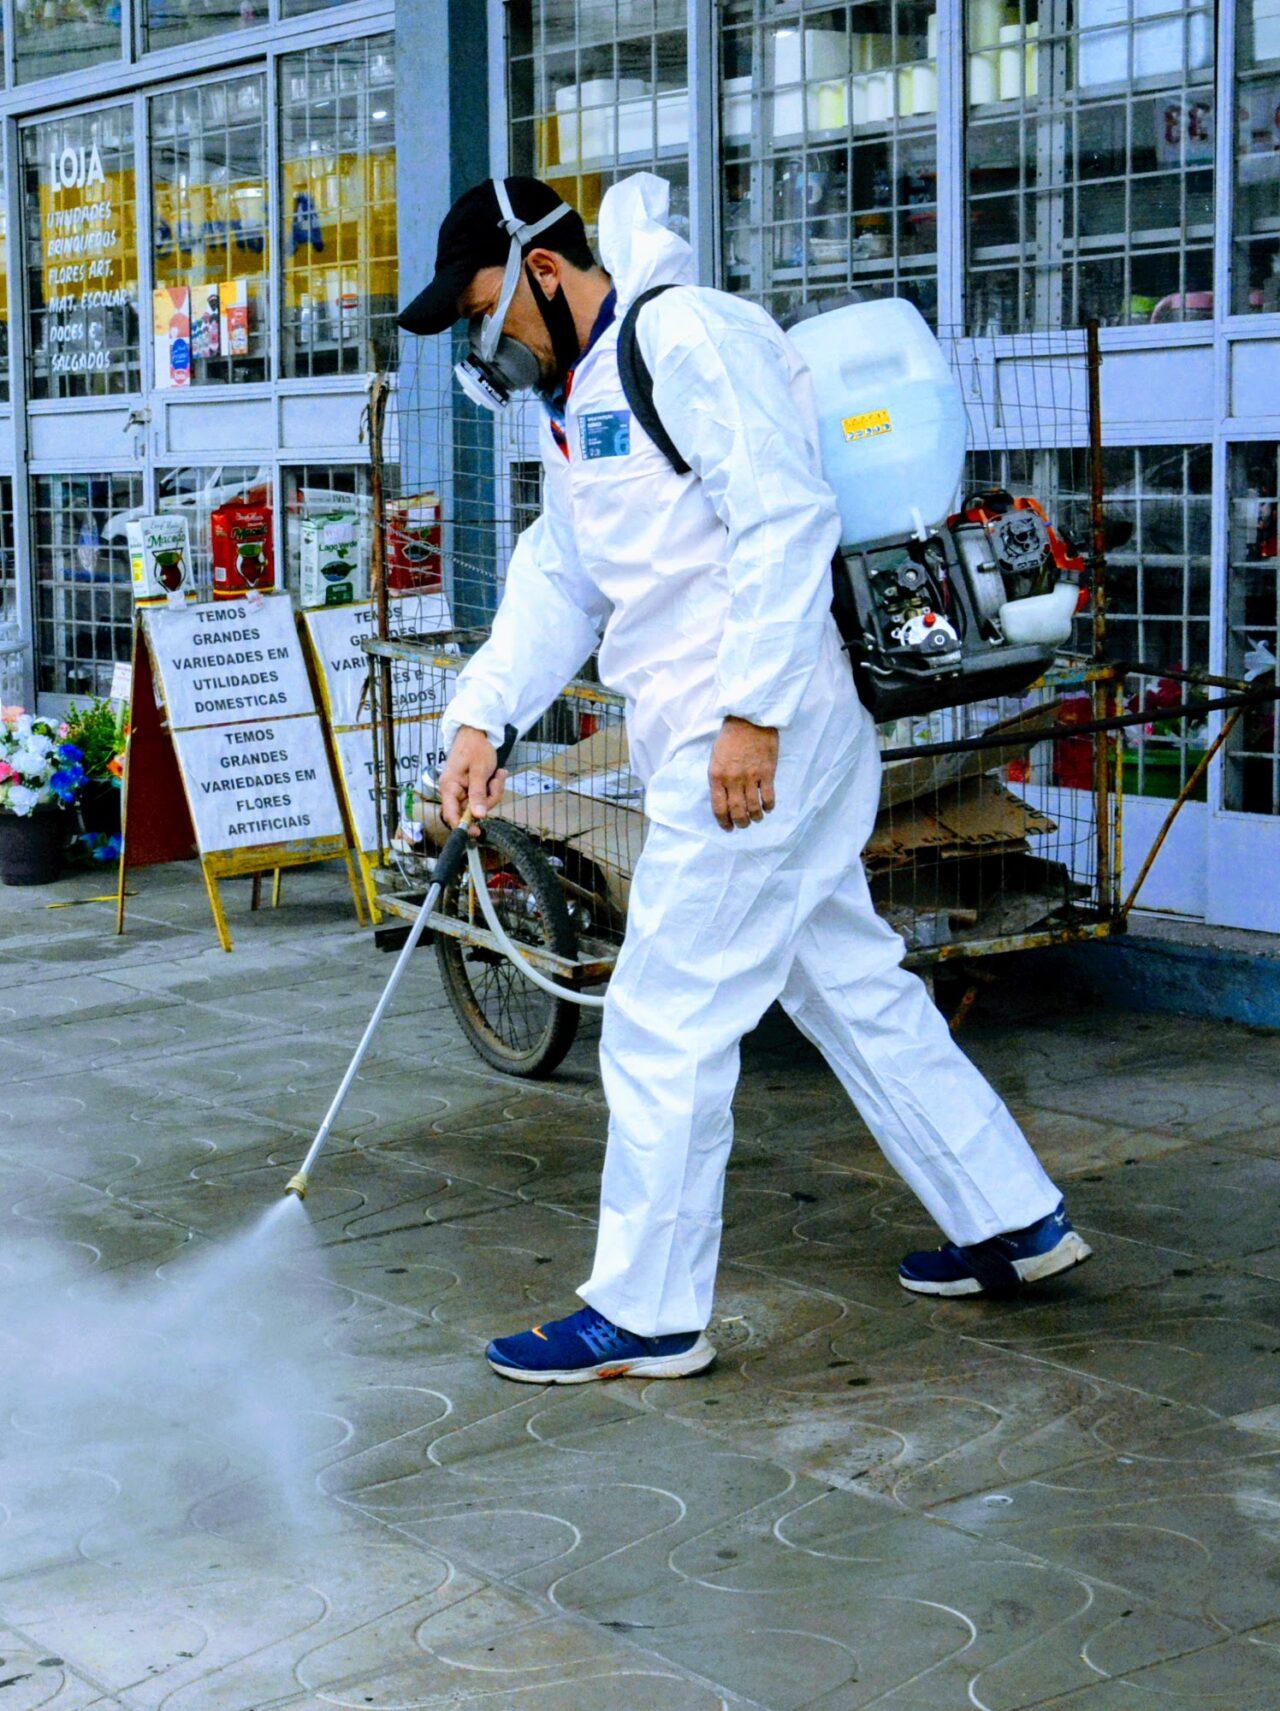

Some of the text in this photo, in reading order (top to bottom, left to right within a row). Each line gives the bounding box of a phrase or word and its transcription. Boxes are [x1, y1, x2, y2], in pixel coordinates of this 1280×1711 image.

[50, 142, 106, 193] LOJA
[48, 229, 117, 257] BRINQUEDOS
[48, 259, 114, 285] FLORES ART.
[49, 288, 128, 313] MAT. ESCOLAR
[50, 322, 98, 342] DOCES E
[52, 350, 111, 372] SALGADOS
[196, 607, 247, 623] TEMOS
[193, 628, 261, 646] GRANDES
[172, 647, 290, 671] VARIEDADES EM
[192, 670, 279, 691] UTILIDADES
[195, 691, 288, 714] DOMESTICAS
[224, 728, 275, 745] TEMOS
[220, 749, 289, 769] GRANDES
[364, 754, 420, 775] TEOS
[200, 768, 317, 794] VARIEDADES EM
[236, 794, 292, 812] FLORES
[228, 814, 311, 836] ARTIFICIAIS
